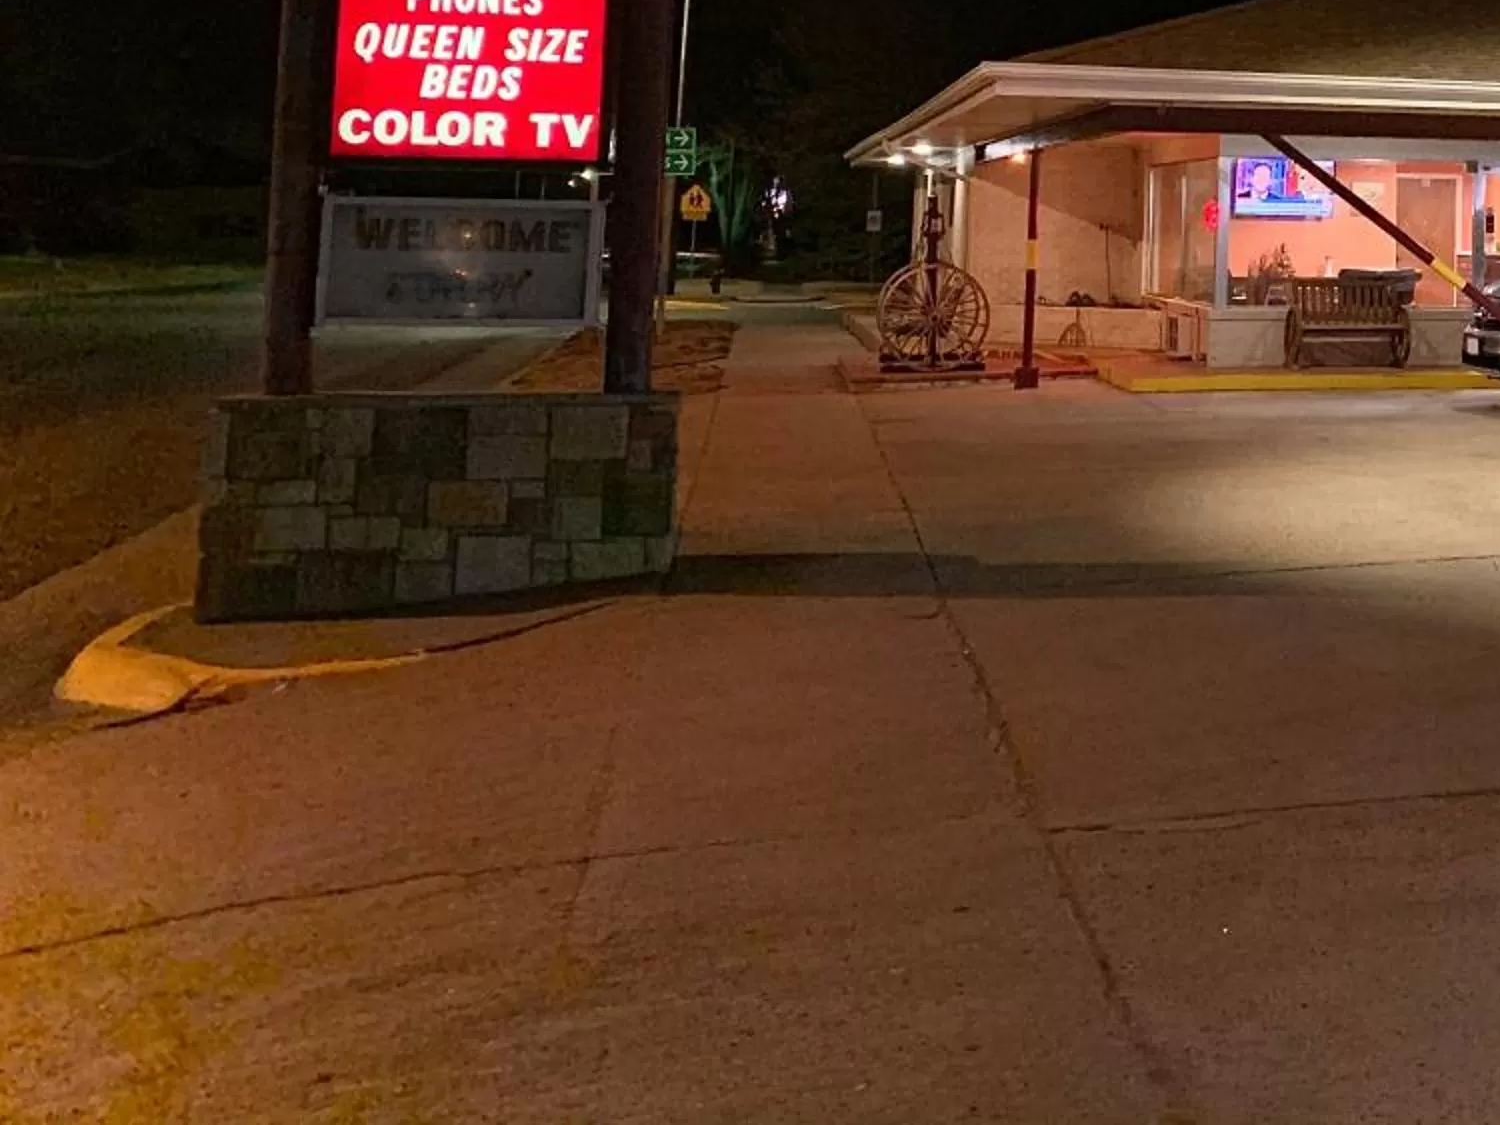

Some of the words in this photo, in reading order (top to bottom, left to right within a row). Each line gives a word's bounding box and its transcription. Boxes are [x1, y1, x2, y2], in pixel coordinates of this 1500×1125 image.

[353, 22, 486, 63] QUEEN
[504, 27, 589, 64] SIZE
[419, 64, 524, 101] BEDS
[338, 108, 508, 147] COLOR
[529, 113, 595, 148] TV
[354, 214, 573, 253] WELCOME
